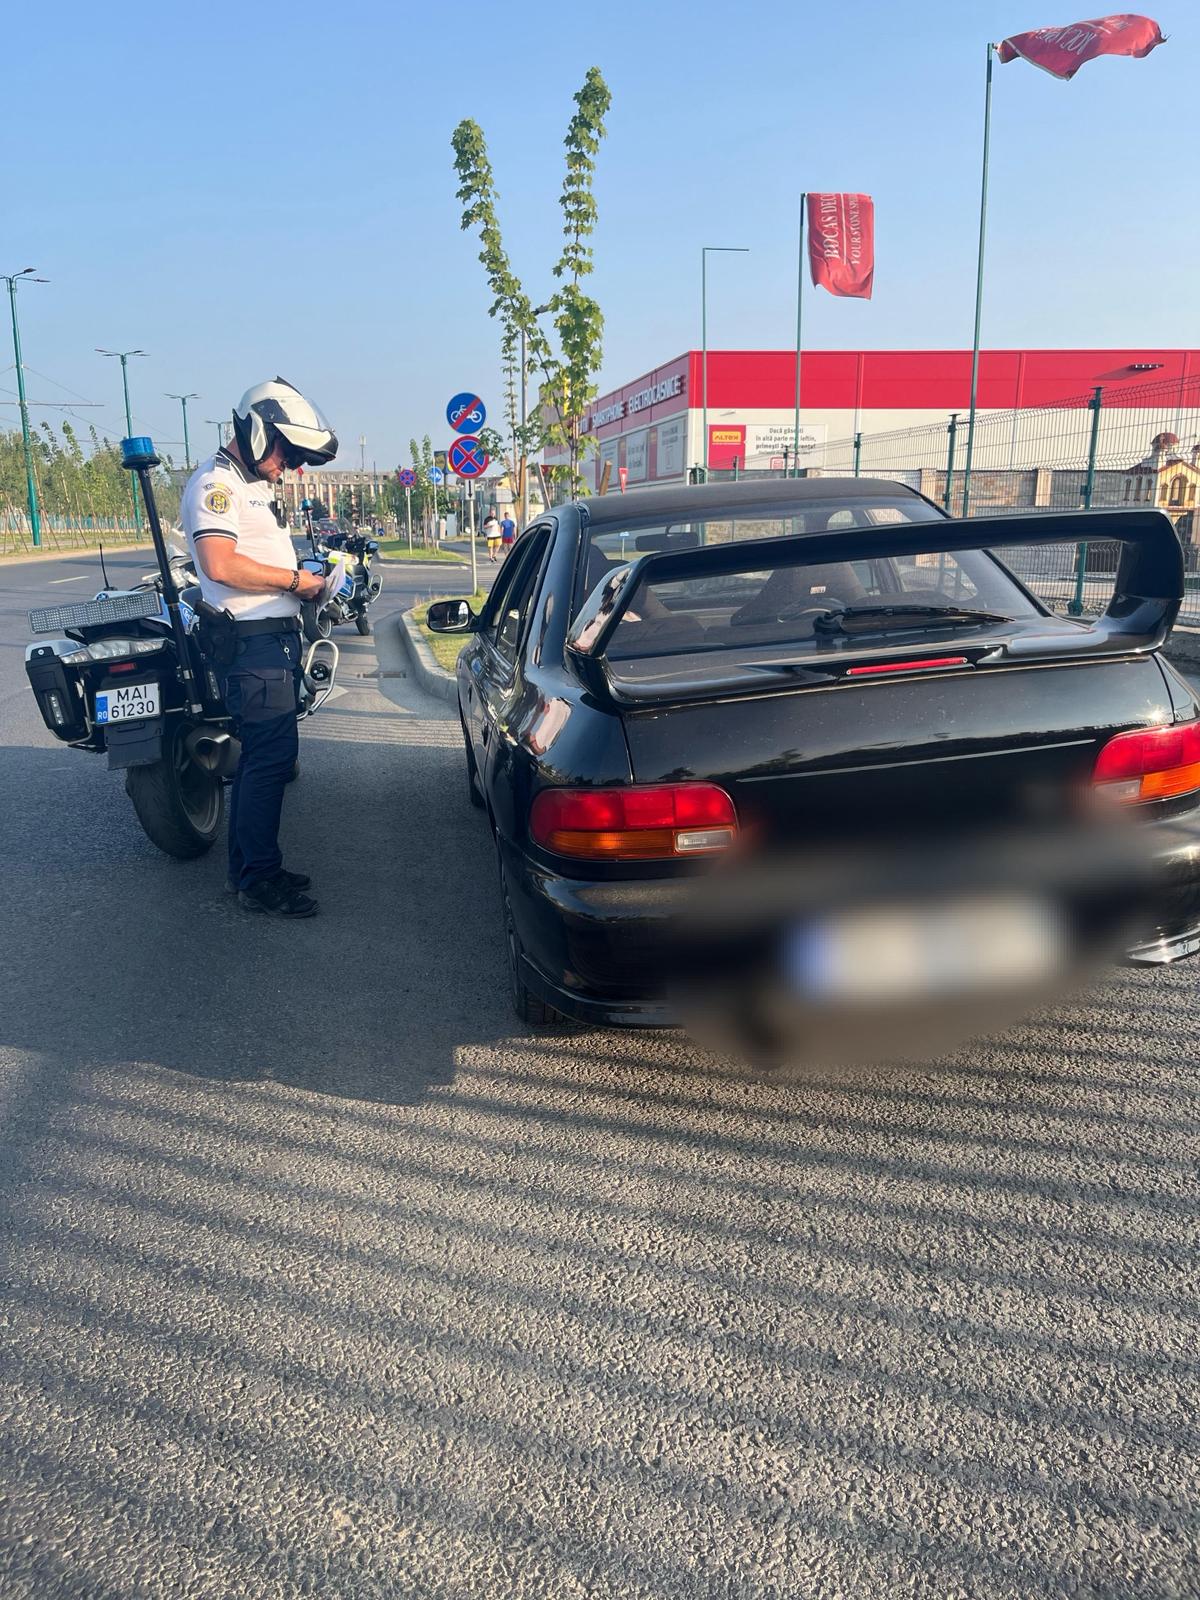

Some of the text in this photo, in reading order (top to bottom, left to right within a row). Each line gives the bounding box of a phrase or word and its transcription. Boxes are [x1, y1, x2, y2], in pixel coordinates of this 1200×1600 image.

[822, 216, 840, 260] BOCAS
[851, 237, 861, 265] YOUR
[628, 374, 682, 414] ELECTROCASNICE
[117, 685, 147, 703] MAI
[97, 710, 108, 721] RO
[111, 700, 155, 719] 61230
